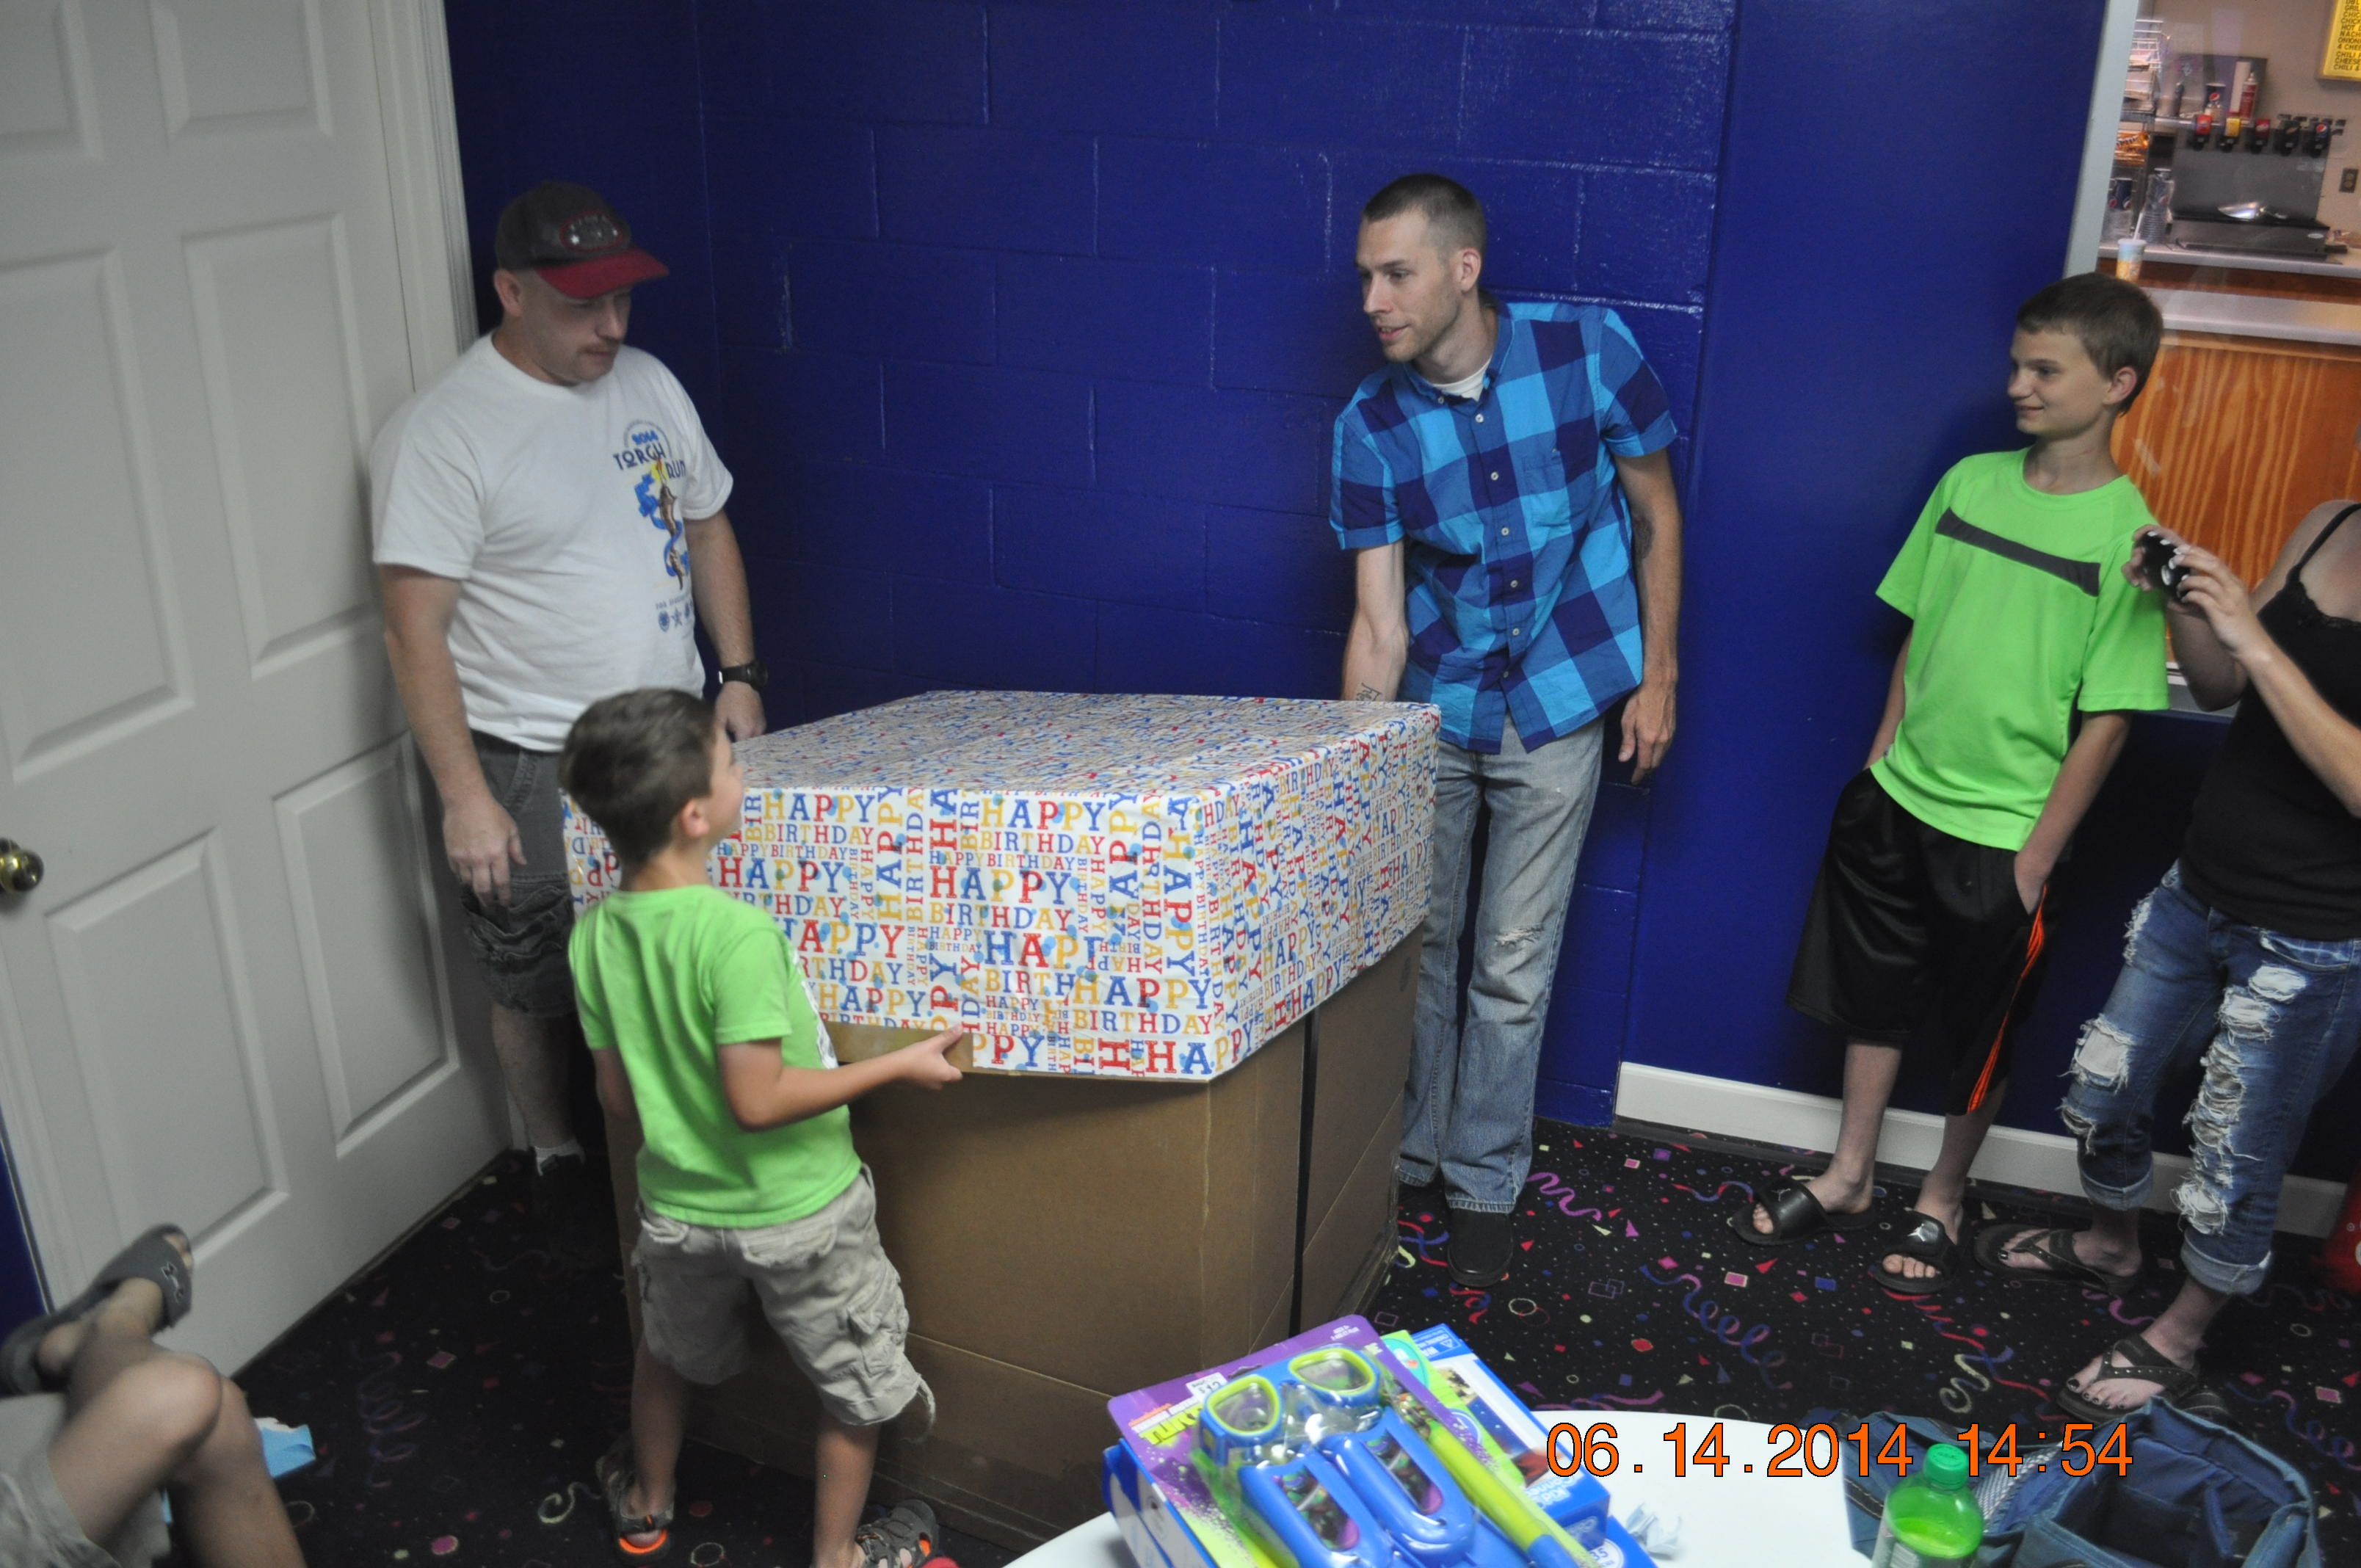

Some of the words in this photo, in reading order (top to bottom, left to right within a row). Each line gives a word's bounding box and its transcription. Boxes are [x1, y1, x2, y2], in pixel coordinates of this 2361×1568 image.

[613, 443, 666, 471] TORCH
[763, 791, 876, 824] HAPPY
[980, 796, 1106, 832] HAPPY
[1360, 739, 1371, 846] APPY
[764, 823, 875, 845] BIRTHDAY
[979, 830, 1106, 855] BIRTHDAY
[1262, 783, 1283, 899] APPY
[1373, 800, 1410, 844] HAPPY
[717, 843, 768, 858] HAPPY
[771, 844, 849, 860] BIRTHDAY
[717, 856, 844, 893] HAPPY
[876, 785, 903, 922] HAPPY
[929, 851, 984, 867] HAPPY
[987, 852, 1076, 871] BIRTHDAY
[1194, 834, 1205, 889] HAPPY
[849, 848, 860, 920] BIRTHDAY
[860, 848, 874, 921] HAPPY
[929, 865, 1072, 905] HAPPY
[1077, 857, 1089, 933] BIRTHDAY
[1091, 858, 1108, 934] HAPPY
[1163, 833, 1194, 977] HAPPY
[1228, 824, 1250, 991] BIRTHDAY
[1238, 815, 1263, 982] HAPPY
[929, 901, 1072, 932] BIRTHDAY
[929, 926, 982, 940] HAPPY
[1197, 894, 1210, 977] BIRTHDAY
[906, 926, 915, 986] BIRTHDAY
[917, 926, 928, 987] HAPPY
[928, 940, 982, 953] BIRTHDAY
[1208, 898, 1225, 1031] BIRTHDAY
[1220, 893, 1239, 1024] HAPPY
[1262, 919, 1315, 978] HAPPY
[818, 981, 926, 1017] HAPPY
[985, 995, 1040, 1011] HAPPY
[1073, 975, 1211, 1010] HAPPY
[1264, 951, 1316, 1001] BIRTHDAY
[1291, 957, 1343, 1020] HAPPY
[1073, 1008, 1213, 1036] BIRTHDAY
[1145, 1018, 1254, 1075] HAPPY
